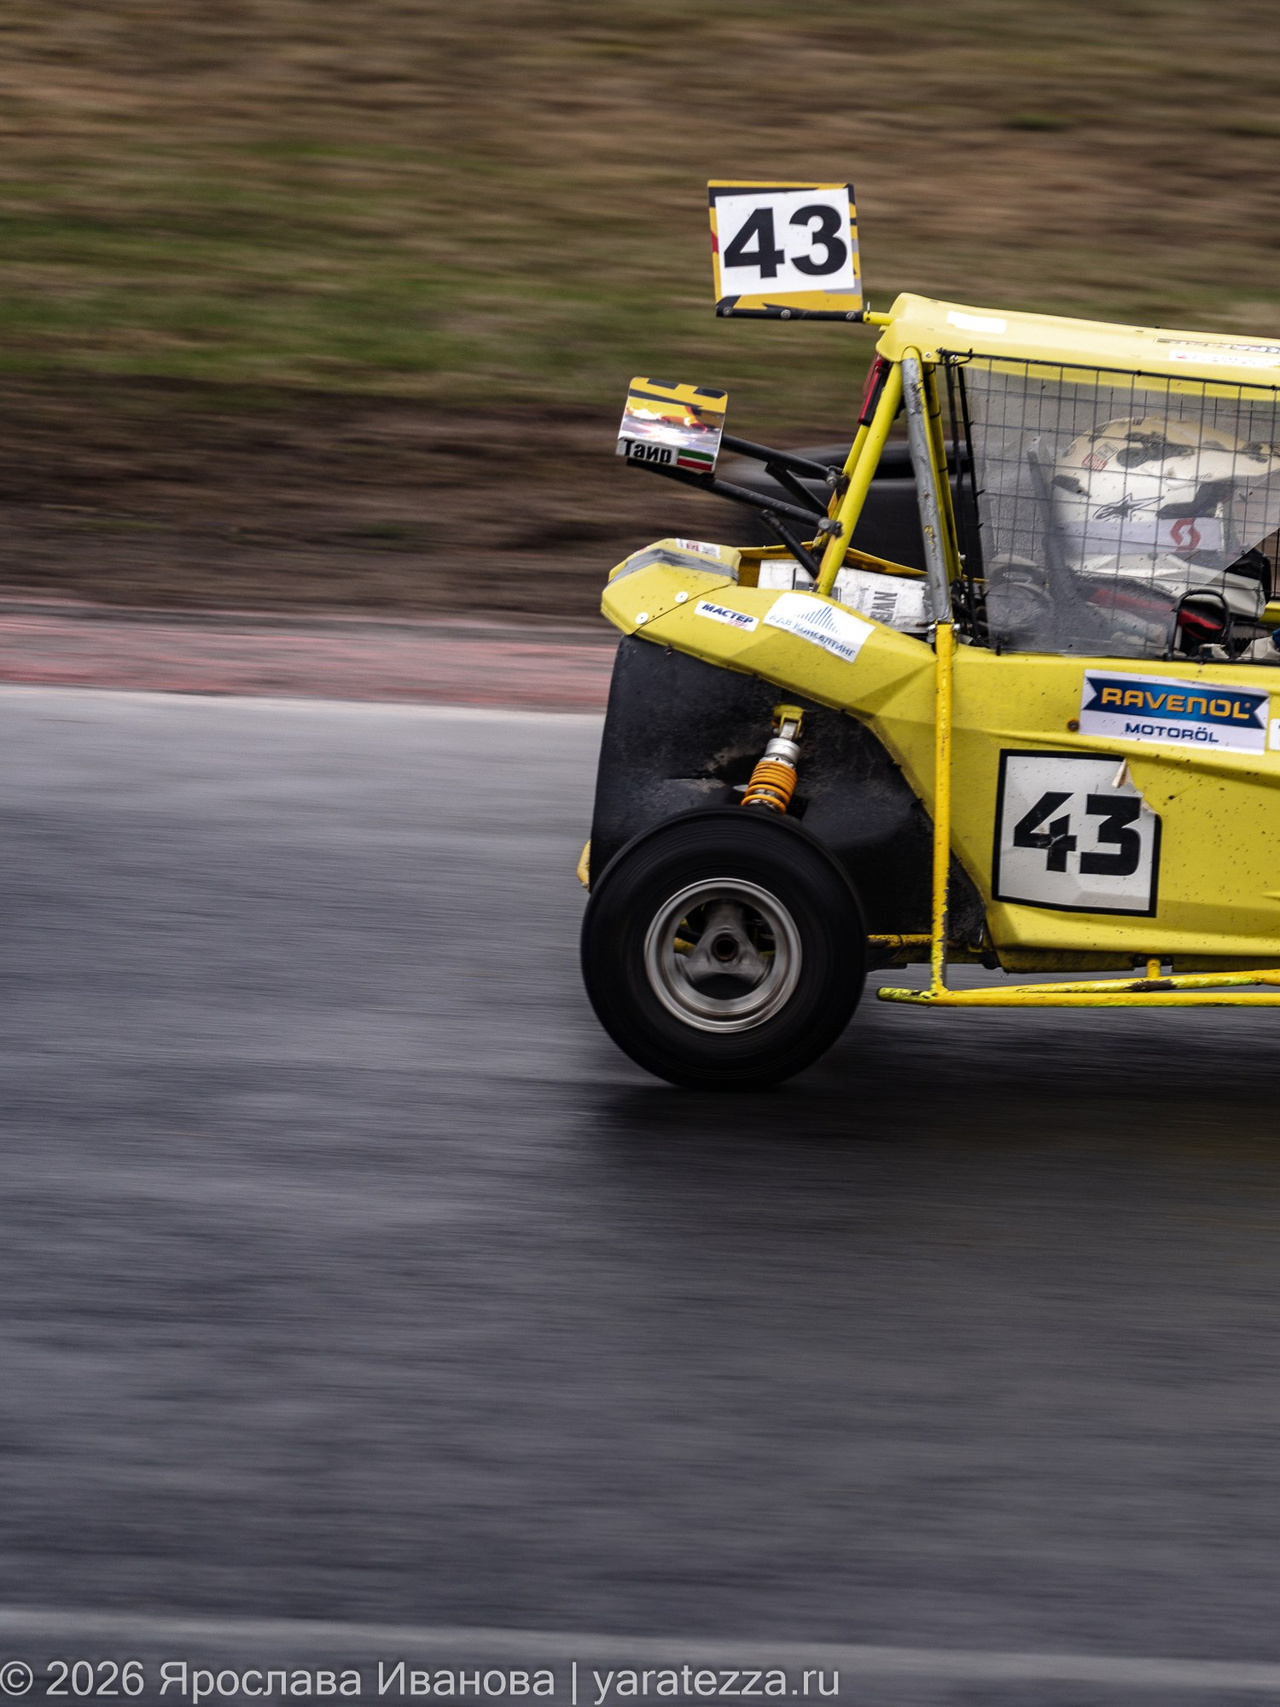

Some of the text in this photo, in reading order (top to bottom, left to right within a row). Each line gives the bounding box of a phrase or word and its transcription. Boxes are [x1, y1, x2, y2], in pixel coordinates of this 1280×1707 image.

[724, 204, 848, 279] 43
[623, 438, 673, 464] Таир
[701, 603, 754, 624] МАСТЕР
[1101, 687, 1250, 720] RAVENOL
[1125, 722, 1219, 743] MOTORÖL
[1013, 791, 1142, 877] 43
